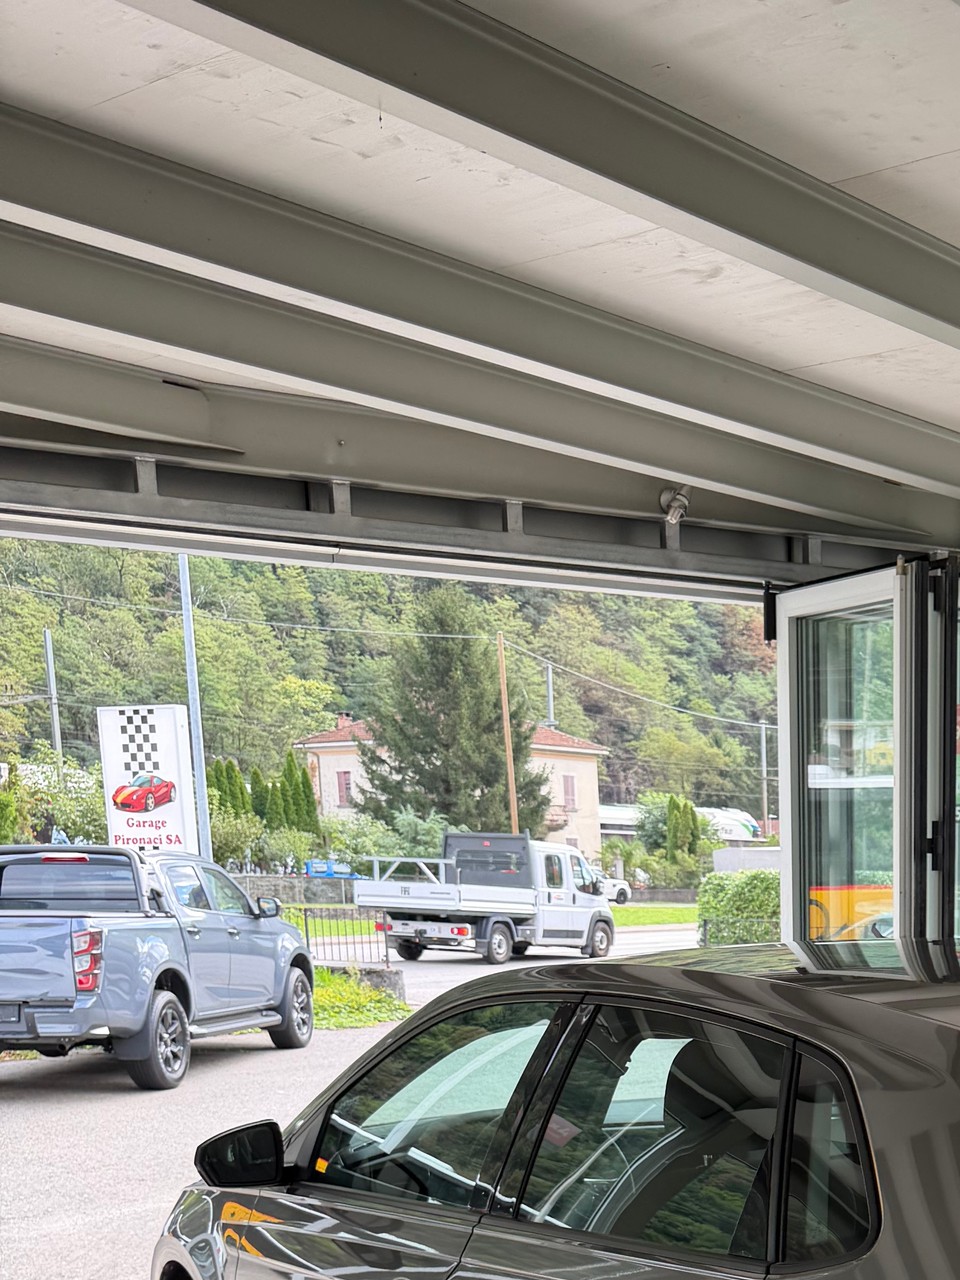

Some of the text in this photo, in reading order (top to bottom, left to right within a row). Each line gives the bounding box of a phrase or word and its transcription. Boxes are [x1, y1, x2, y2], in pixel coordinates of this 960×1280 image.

[127, 818, 167, 830] Garage
[114, 834, 182, 845] Pironaci SA
